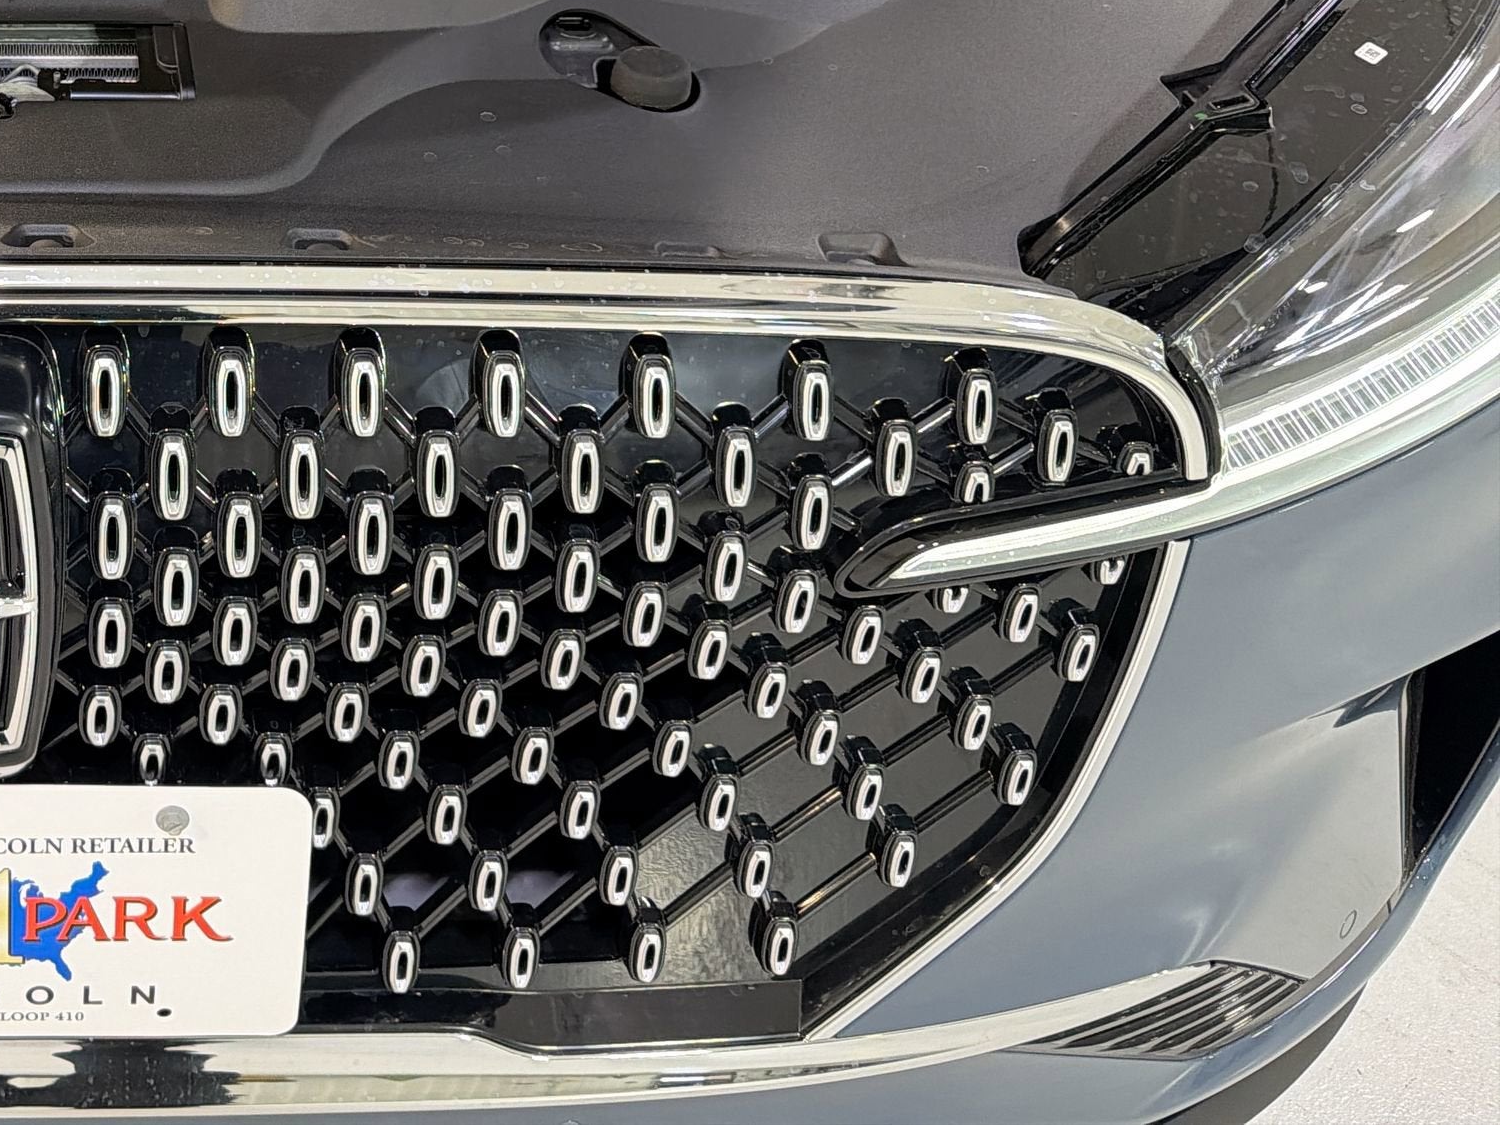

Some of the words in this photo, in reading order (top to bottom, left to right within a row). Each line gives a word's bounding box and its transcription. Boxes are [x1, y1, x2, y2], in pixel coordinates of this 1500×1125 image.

[70, 837, 196, 854] RETAILER
[22, 895, 234, 943] PARK
[0, 1012, 50, 1022] LOOP
[55, 1012, 84, 1022] 410
